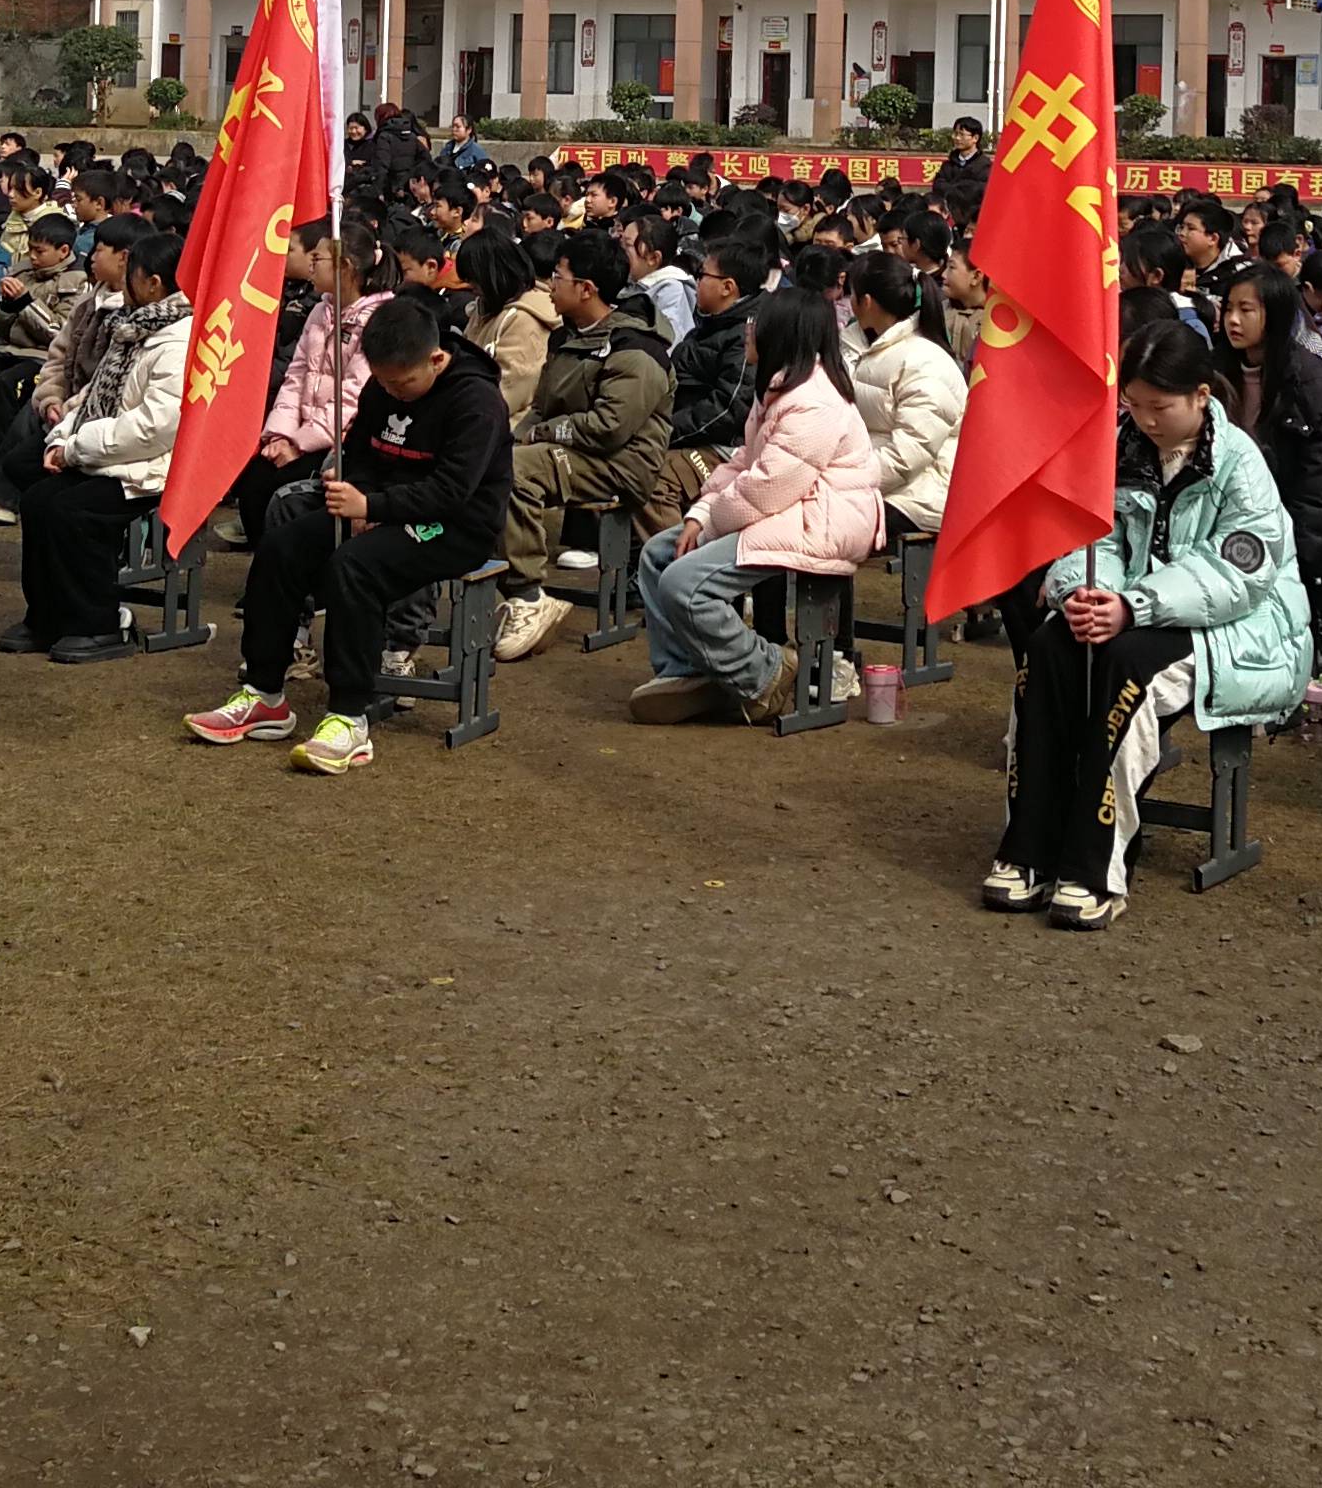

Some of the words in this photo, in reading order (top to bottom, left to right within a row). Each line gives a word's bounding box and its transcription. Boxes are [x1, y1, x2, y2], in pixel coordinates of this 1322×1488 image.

[667, 151, 772, 178] 警长鸣
[790, 156, 900, 182] 奋发图强
